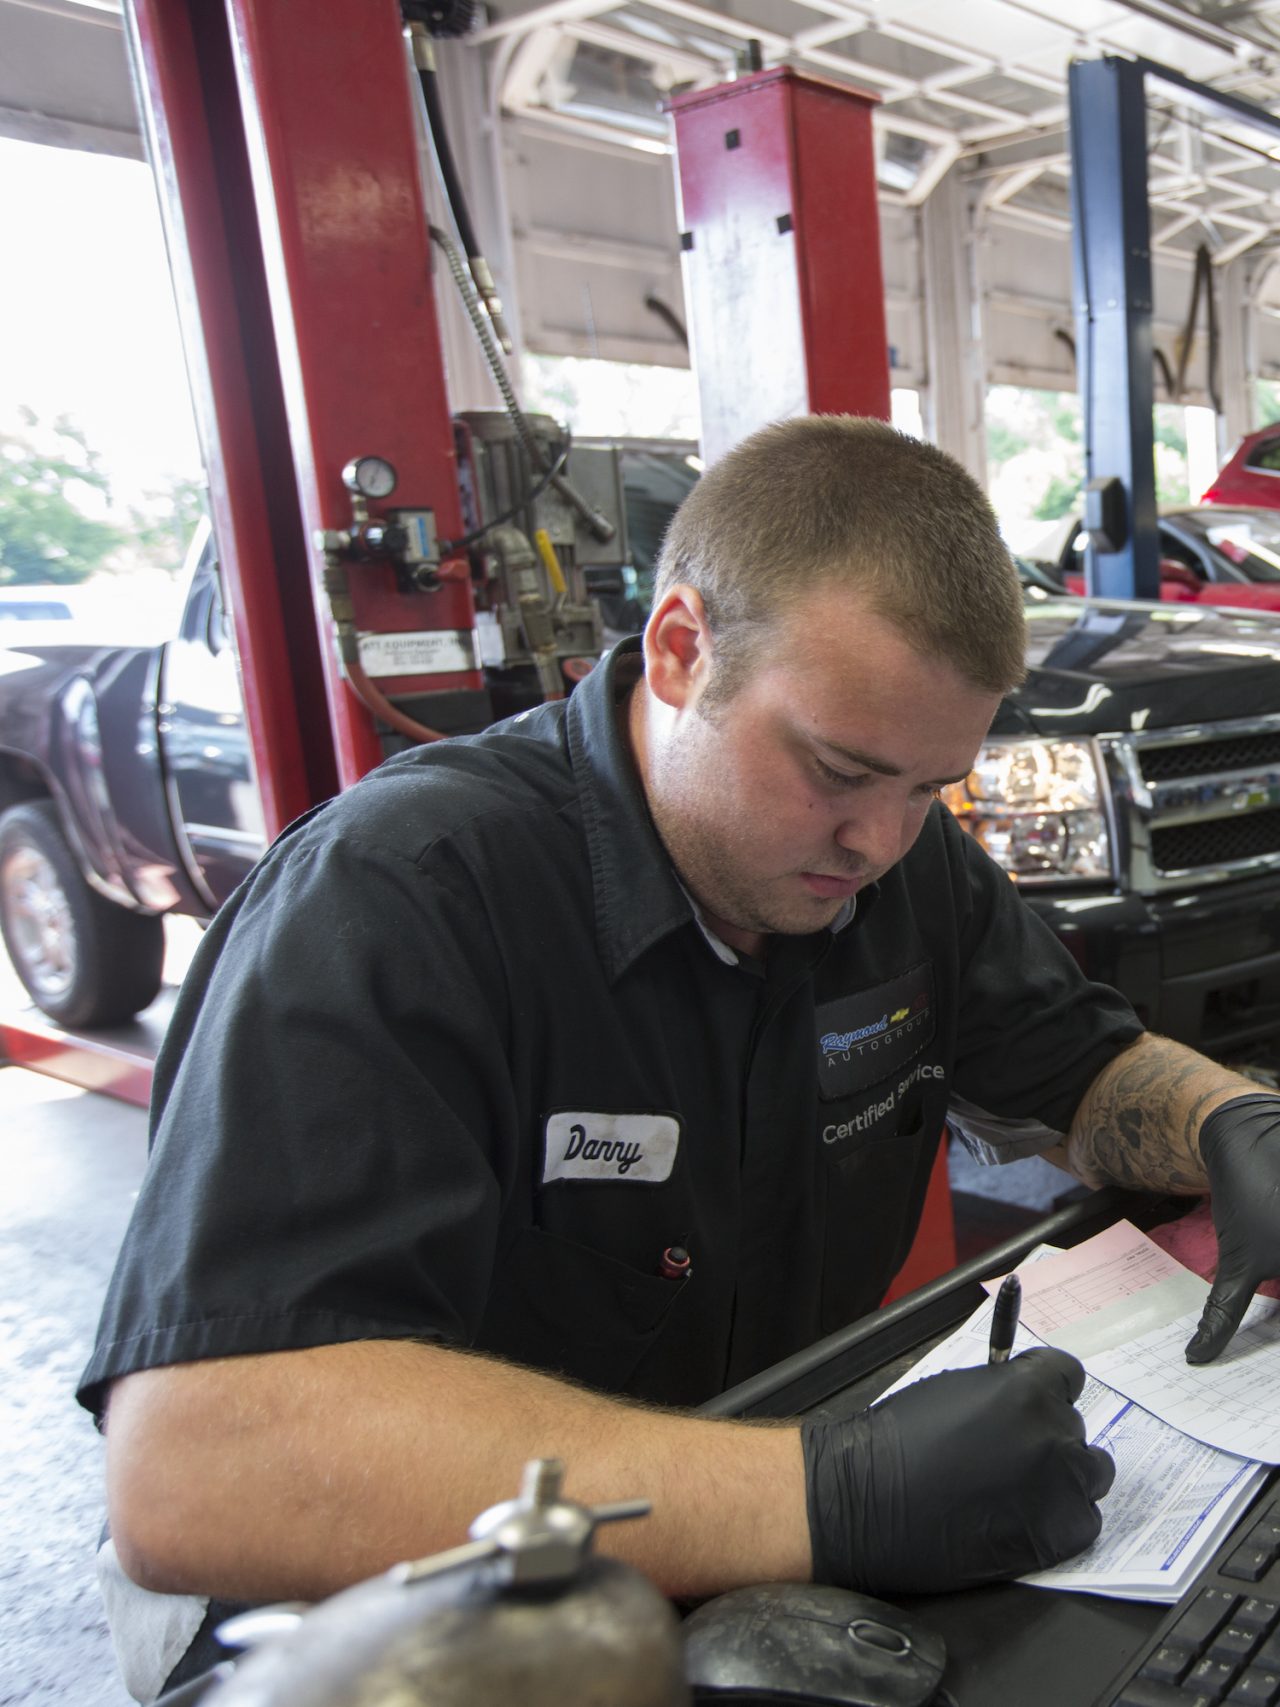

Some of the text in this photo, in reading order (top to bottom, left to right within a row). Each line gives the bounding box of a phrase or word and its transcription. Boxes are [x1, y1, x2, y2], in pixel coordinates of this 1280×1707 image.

[820, 1014, 888, 1055] Raymond
[822, 1092, 895, 1145] Certified
[563, 1124, 643, 1175] Danny
